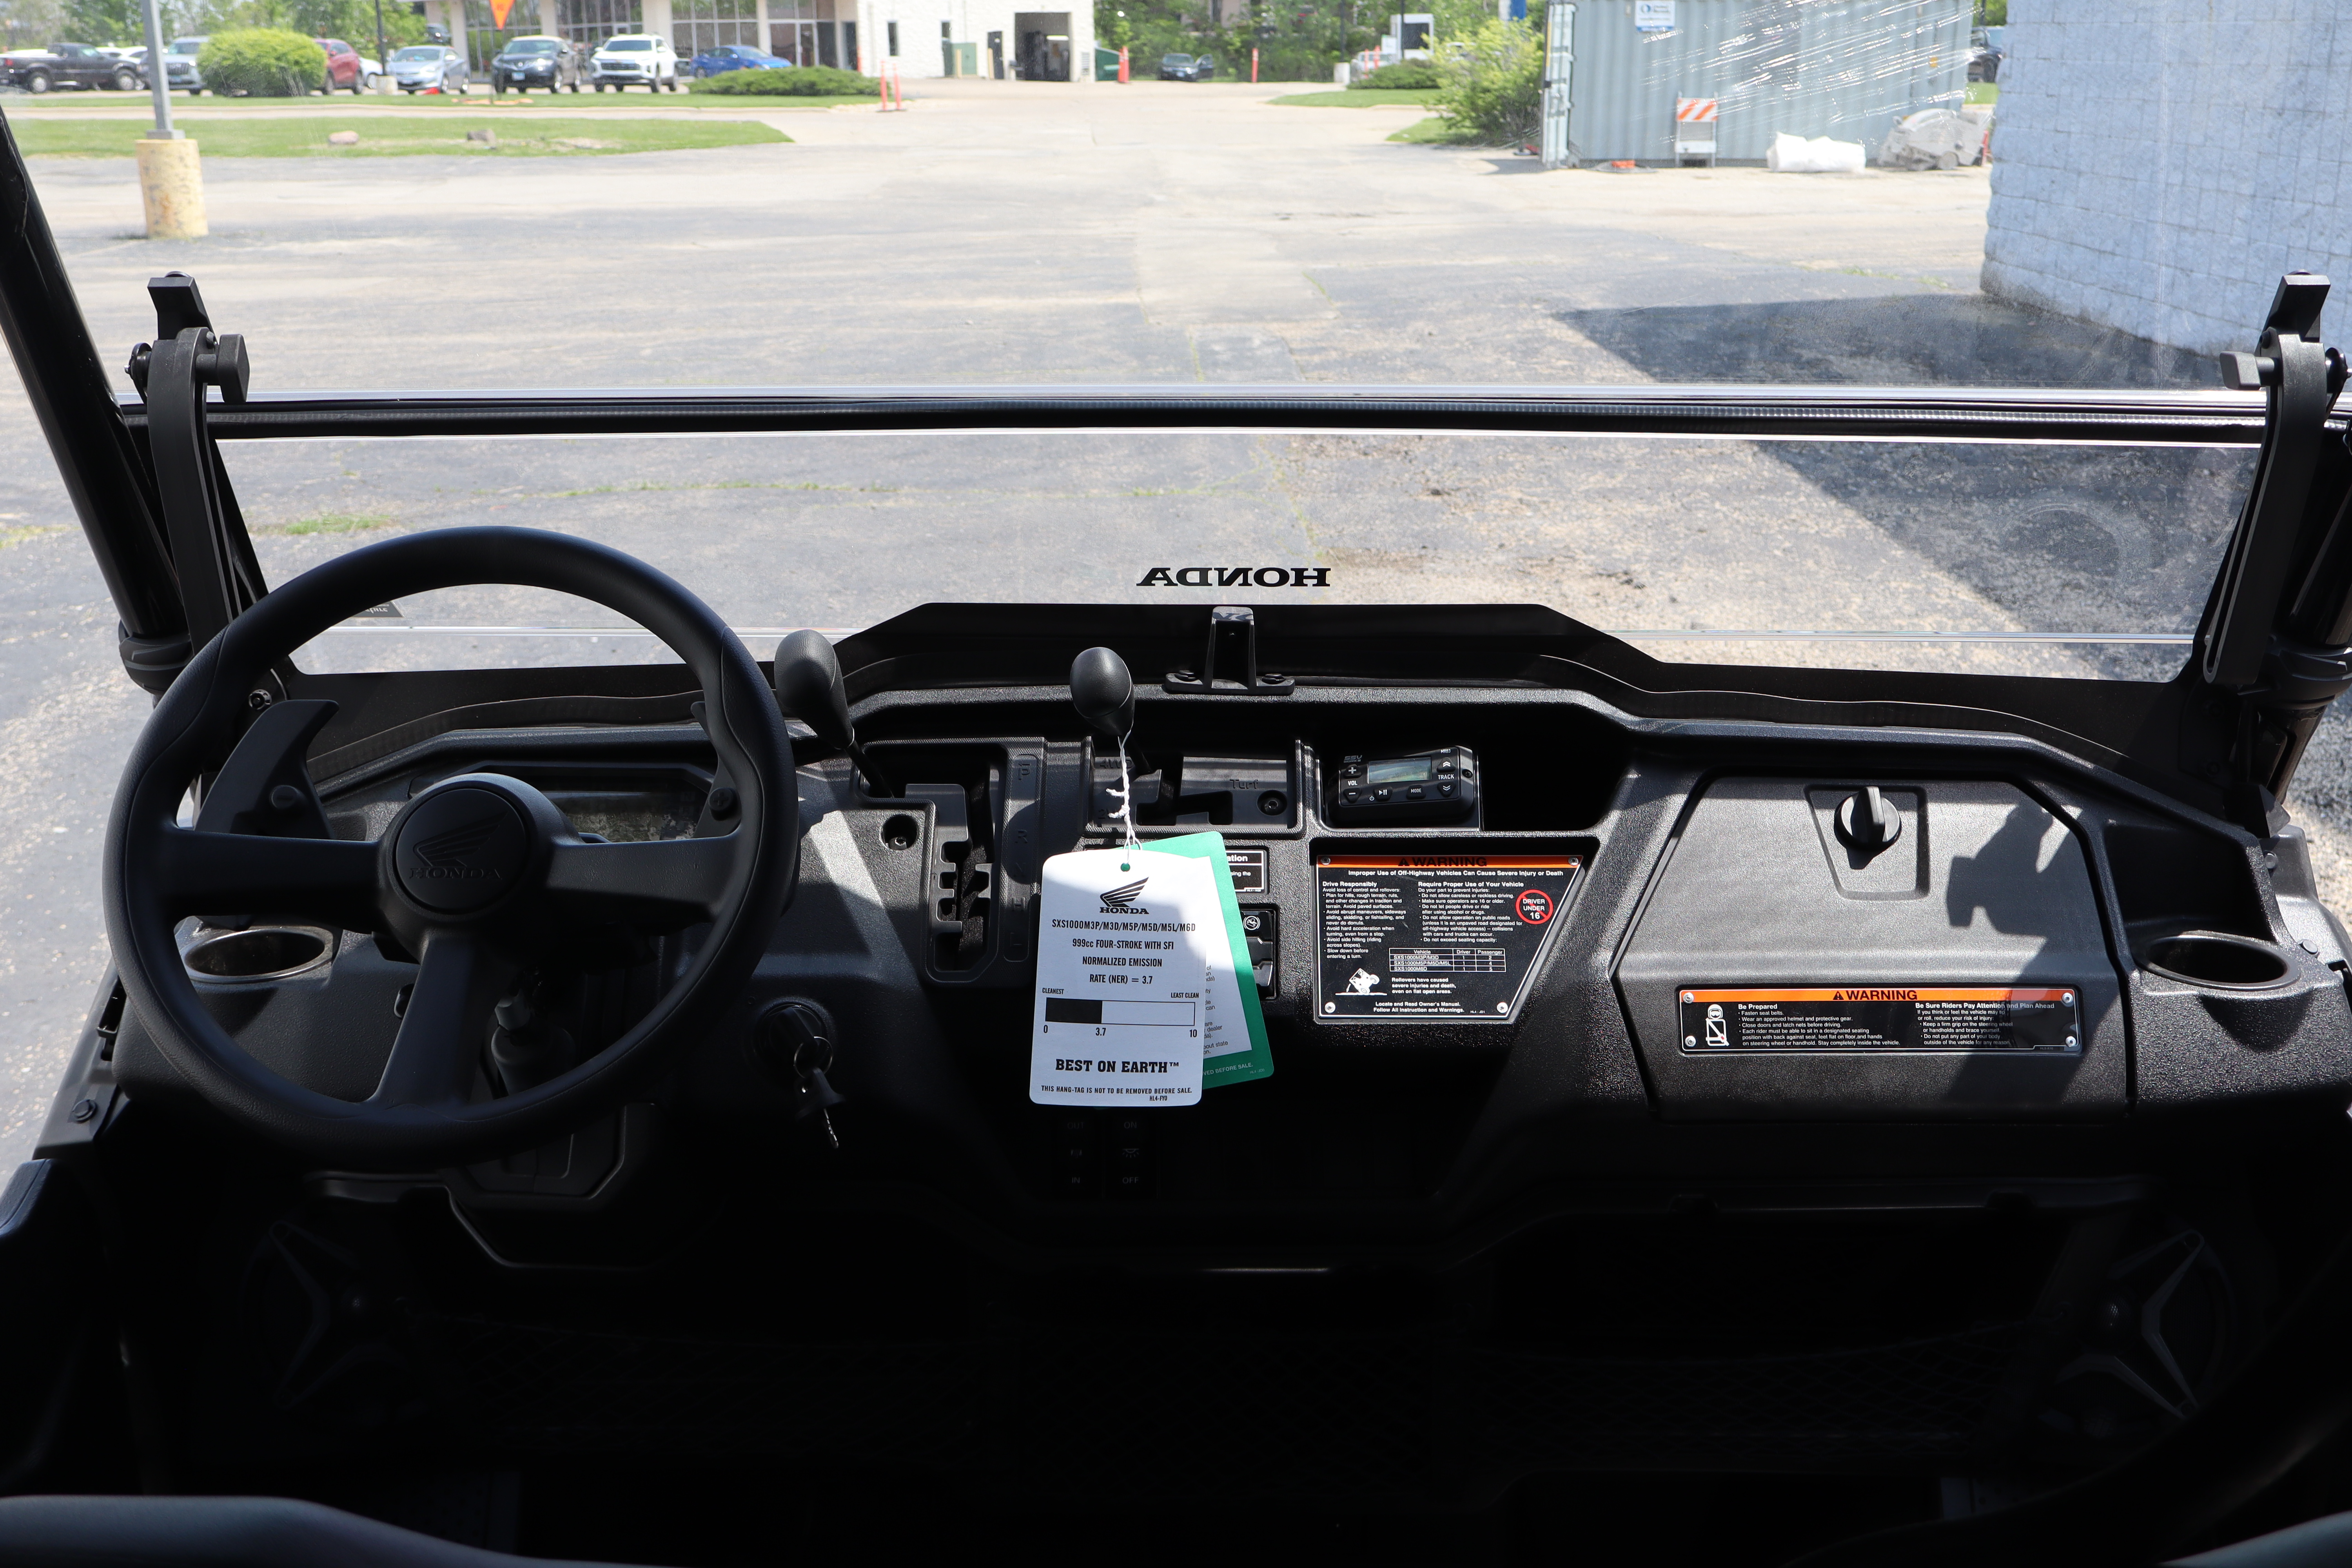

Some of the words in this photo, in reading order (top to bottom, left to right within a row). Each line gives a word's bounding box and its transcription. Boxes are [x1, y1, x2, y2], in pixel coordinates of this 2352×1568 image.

[1230, 779, 1258, 789] Turf
[1412, 857, 1487, 867] WARNING
[410, 867, 503, 880] HONDA
[1099, 906, 1149, 915] HONDA
[1051, 919, 1196, 932] SXS1000M3P/M3D/M5P/M5D/M5L/M6D
[1073, 938, 1094, 947] 999cc
[1096, 939, 1142, 949] FOUR-STROKE
[1144, 941, 1161, 949] WITH
[1163, 941, 1174, 950] SFI
[1082, 956, 1126, 966] NORMALIZED
[1129, 958, 1162, 967] EMISSION
[1089, 974, 1106, 983] RATE
[1109, 975, 1128, 984] (NER)
[1142, 975, 1153, 984] 3.7
[1846, 990, 1918, 1000] WARNING
[1043, 1025, 1048, 1033] 0
[1095, 1027, 1106, 1036] 3.7
[1189, 1029, 1197, 1038] 10
[1055, 1059, 1093, 1072] BEST
[1098, 1060, 1116, 1073] ON
[1216, 1065, 1237, 1073] BEFORE
